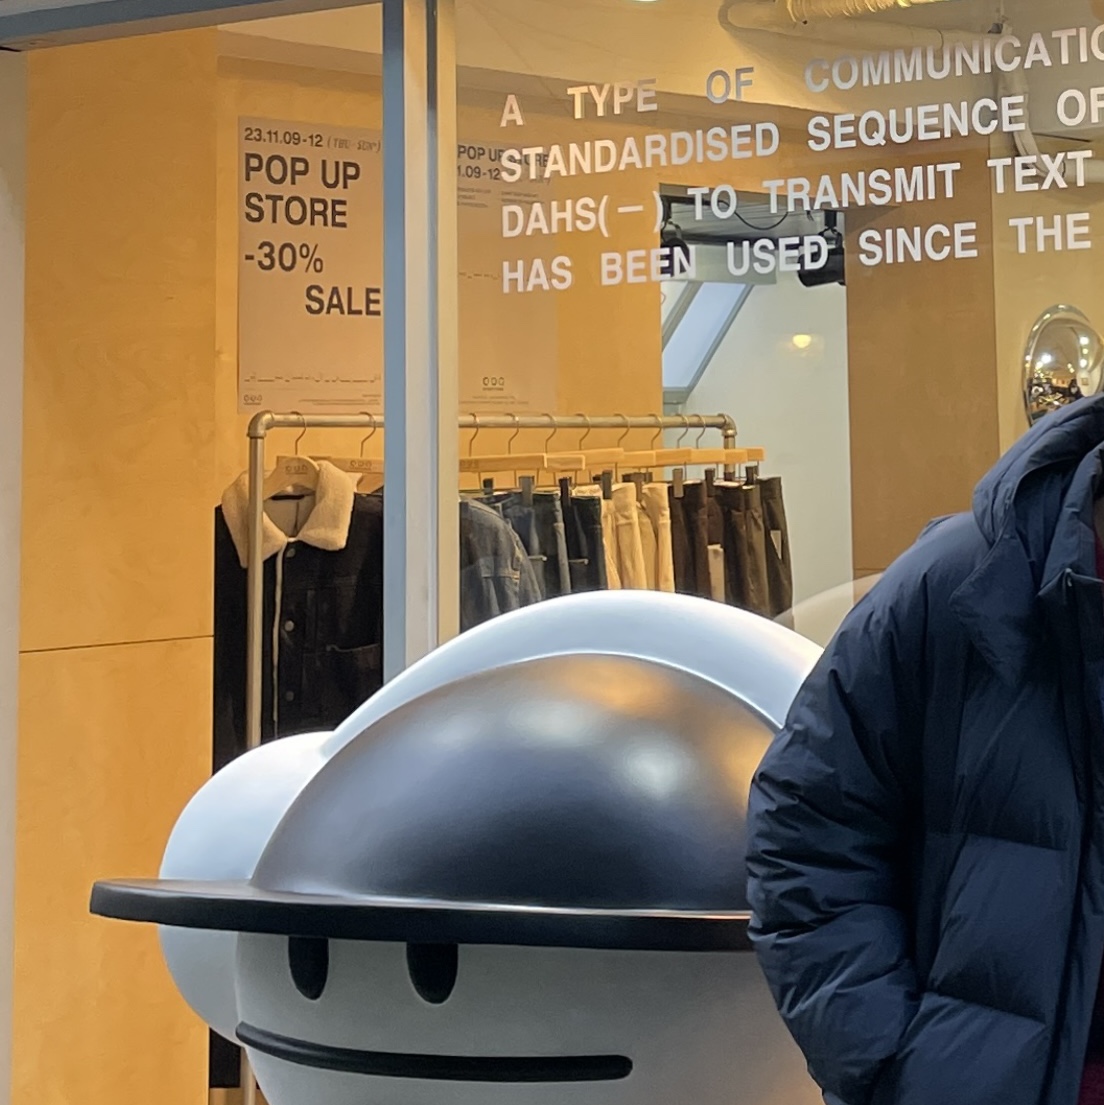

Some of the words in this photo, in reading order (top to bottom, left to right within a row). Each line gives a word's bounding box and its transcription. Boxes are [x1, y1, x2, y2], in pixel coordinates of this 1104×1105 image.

[500, 95, 523, 127] A
[567, 79, 658, 119] TYPE
[706, 67, 755, 103] OF
[244, 127, 324, 148] 23.11.09-12
[457, 145, 485, 161] POP
[500, 122, 780, 183] STANDARDISED
[807, 98, 1025, 151] SEQUENCE
[245, 152, 309, 185] POP
[321, 159, 361, 189] UP
[687, 184, 737, 221] TO
[762, 162, 961, 214] TRANSMIT
[987, 150, 1093, 193] TEXT
[244, 192, 348, 228] STORE
[244, 241, 324, 273] -30%
[501, 256, 573, 294] HAS
[601, 246, 696, 286] BEEN
[727, 235, 830, 277] USED
[858, 222, 978, 267] SINCE
[1008, 212, 1092, 254] THE
[305, 285, 382, 316] SALE
